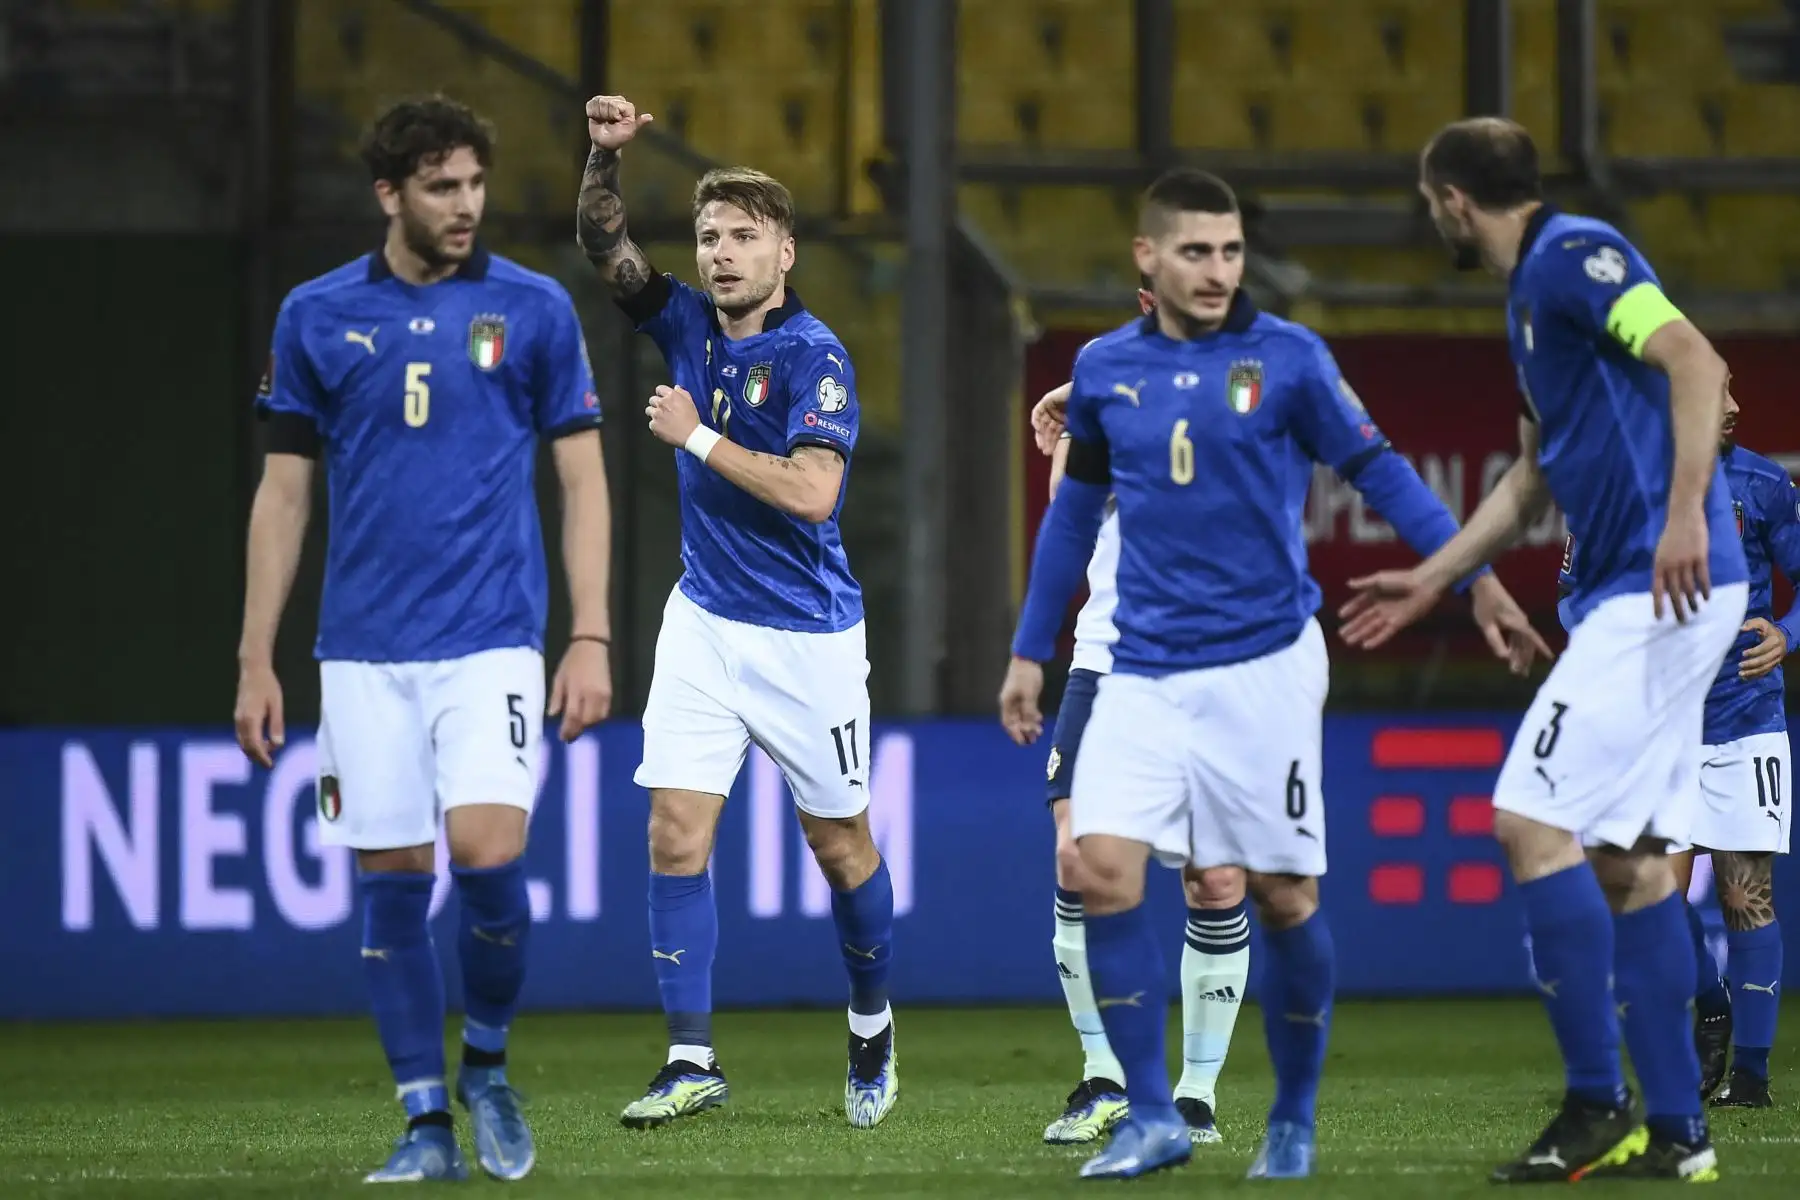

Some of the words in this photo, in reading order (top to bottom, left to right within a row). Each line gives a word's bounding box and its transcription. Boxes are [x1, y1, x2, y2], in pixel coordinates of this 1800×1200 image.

[404, 362, 431, 428] 5
[817, 418, 851, 437] RESPECT
[1170, 418, 1194, 486] 6
[507, 694, 526, 750] 5
[830, 718, 859, 776] 17
[1533, 701, 1570, 760] 3
[1286, 759, 1307, 821] 6
[1753, 755, 1782, 808] 10
